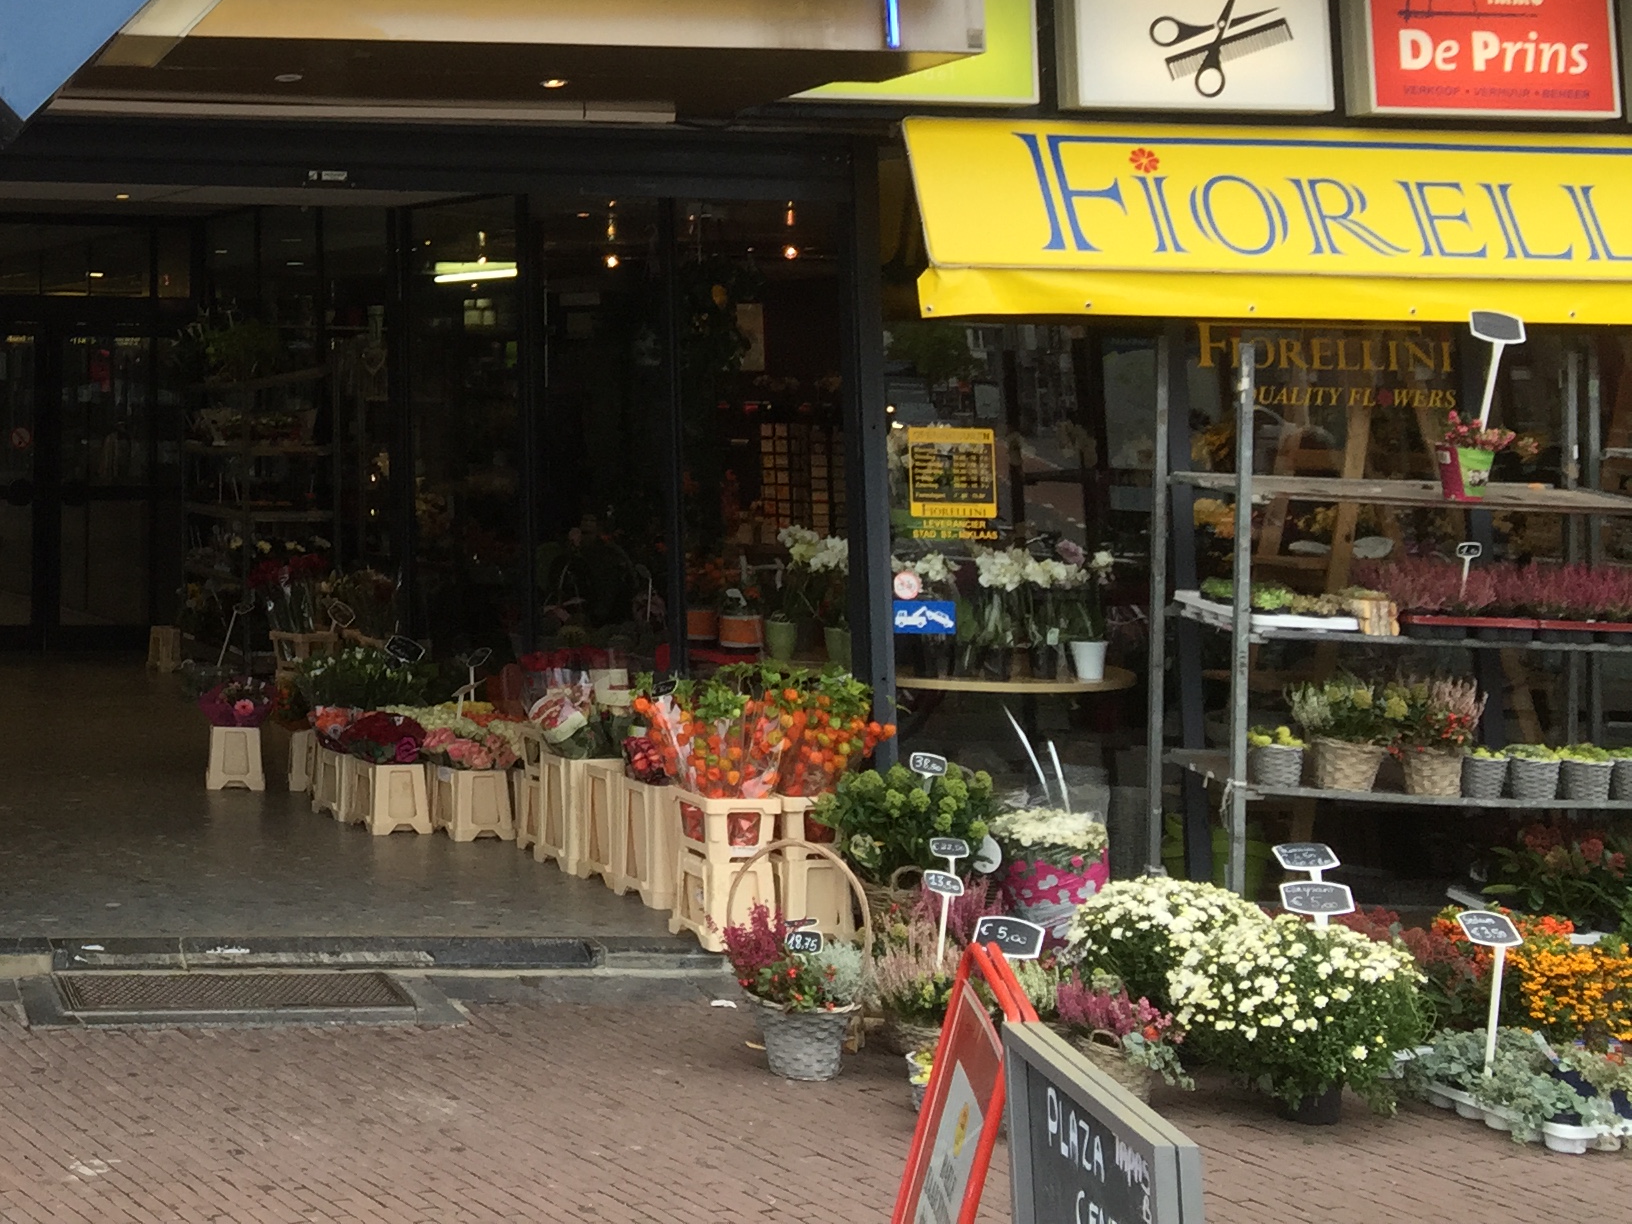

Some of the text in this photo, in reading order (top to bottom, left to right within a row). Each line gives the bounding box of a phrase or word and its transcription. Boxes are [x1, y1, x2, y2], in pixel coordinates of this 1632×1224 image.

[1399, 30, 1590, 76] De Prins
[1250, 385, 1344, 407] UALITY
[980, 922, 1028, 945] € 5,00
[1047, 1087, 1106, 1184] PLAZA
